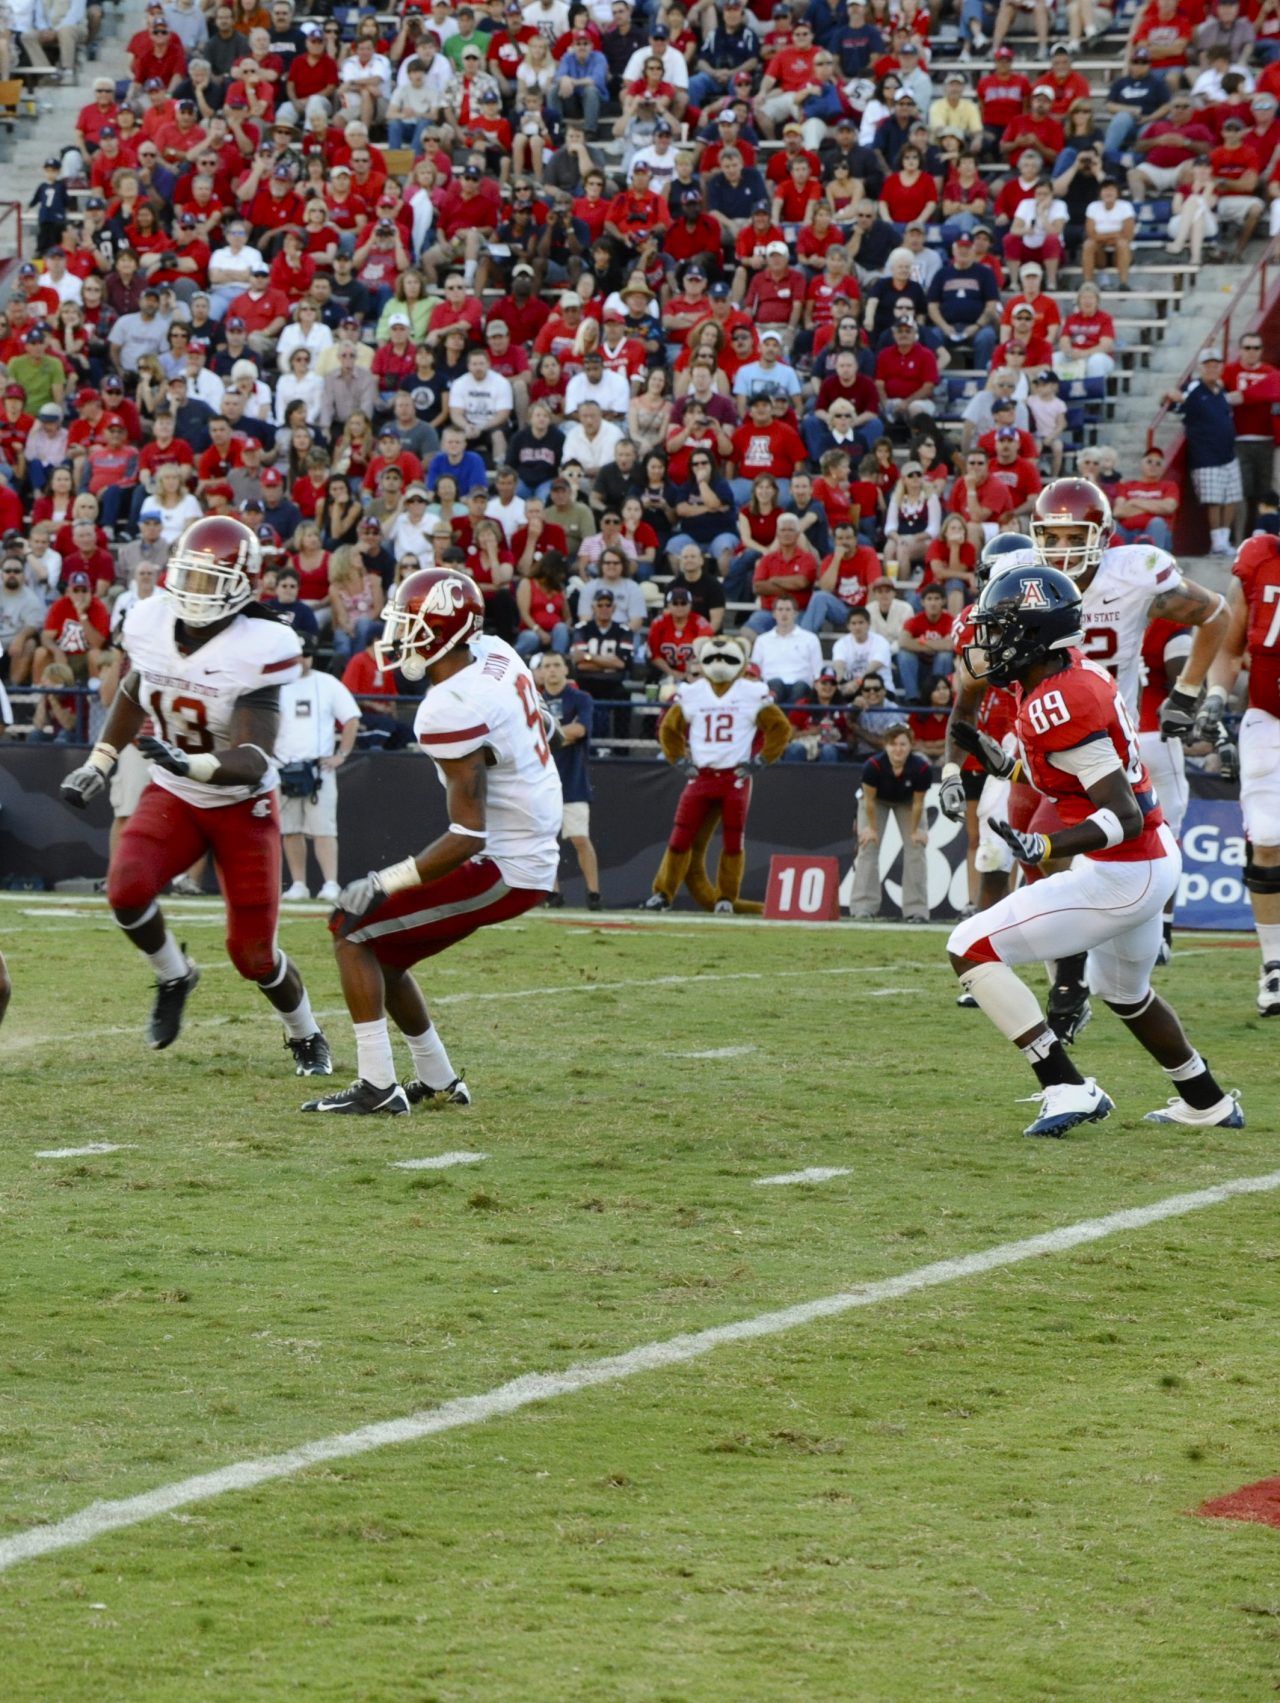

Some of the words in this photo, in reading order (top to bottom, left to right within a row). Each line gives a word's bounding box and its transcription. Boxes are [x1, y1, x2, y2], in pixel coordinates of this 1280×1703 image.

[1093, 611, 1120, 624] STATE
[192, 682, 220, 699] STATE
[150, 690, 216, 755] 13
[703, 713, 734, 743] 12
[1027, 689, 1071, 735] 89
[778, 866, 826, 913] 10
